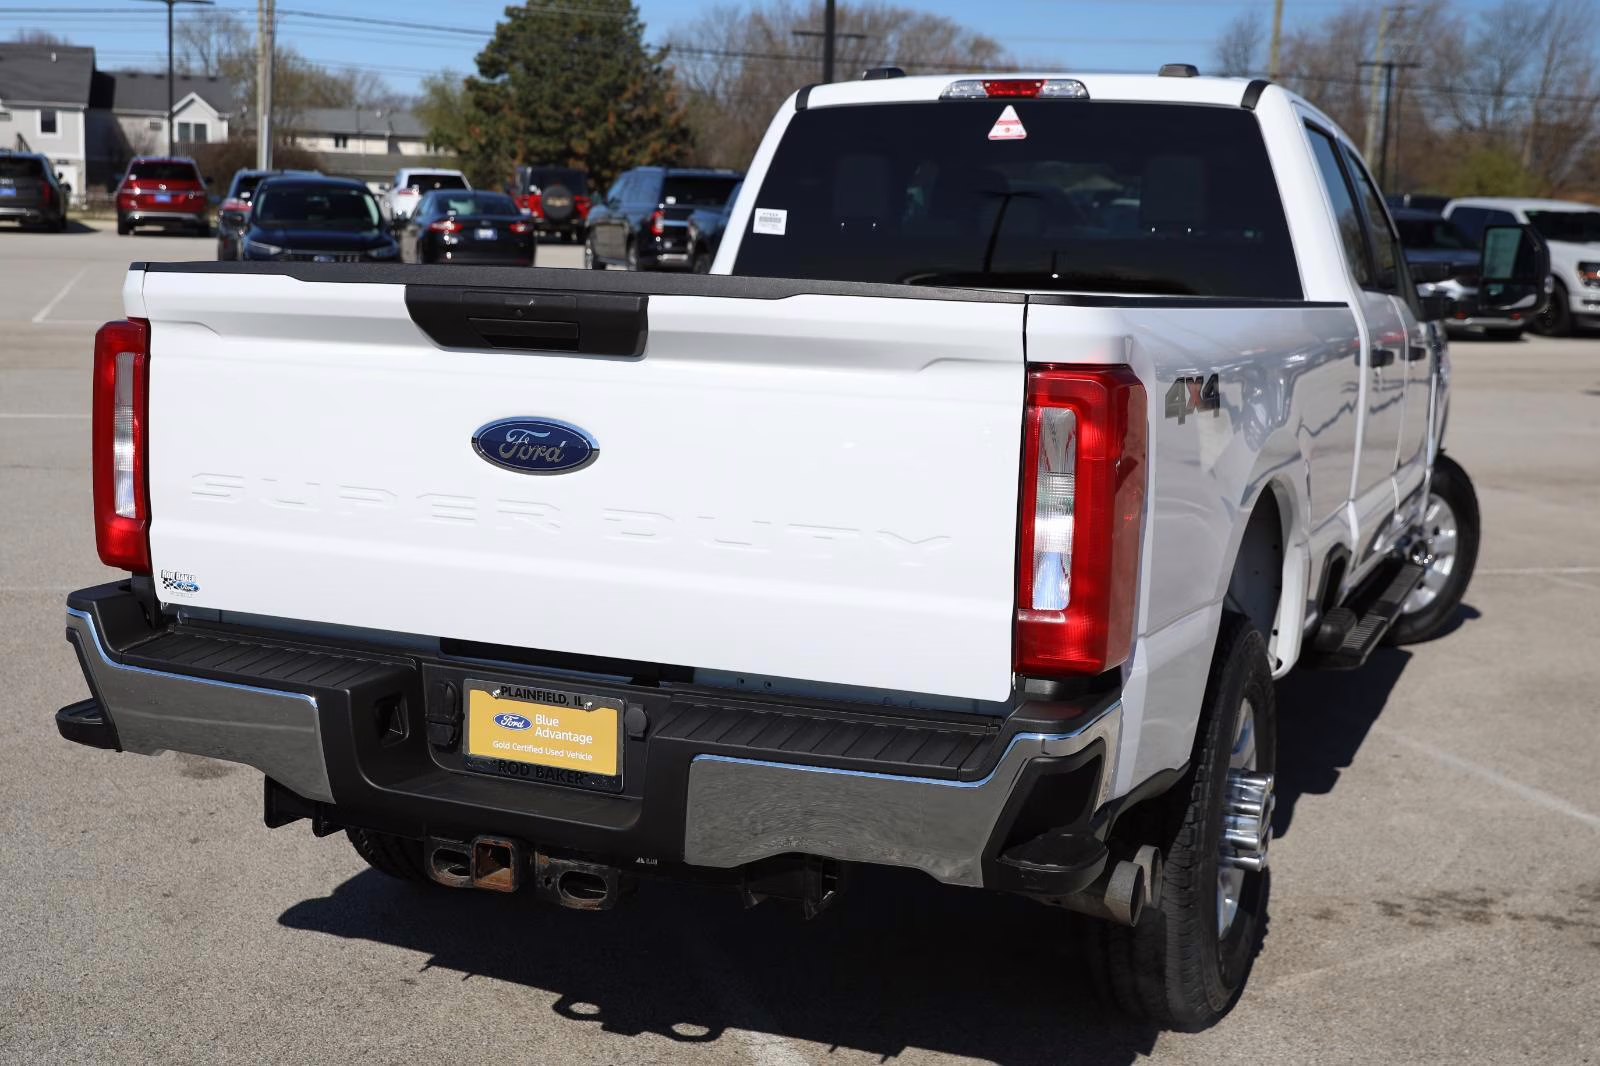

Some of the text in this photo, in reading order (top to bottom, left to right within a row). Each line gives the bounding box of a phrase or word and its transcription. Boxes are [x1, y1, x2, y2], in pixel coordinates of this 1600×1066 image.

[499, 428, 565, 463] Ford
[191, 472, 953, 567] SUPER DUTY
[501, 685, 584, 707] PLAINFIELD, IL
[501, 714, 525, 729] Ford
[535, 713, 559, 727] Blue
[535, 726, 593, 744] Advantage
[492, 740, 593, 761] Gold Certified Used Vehicle
[498, 759, 584, 785] ROD BAKER
